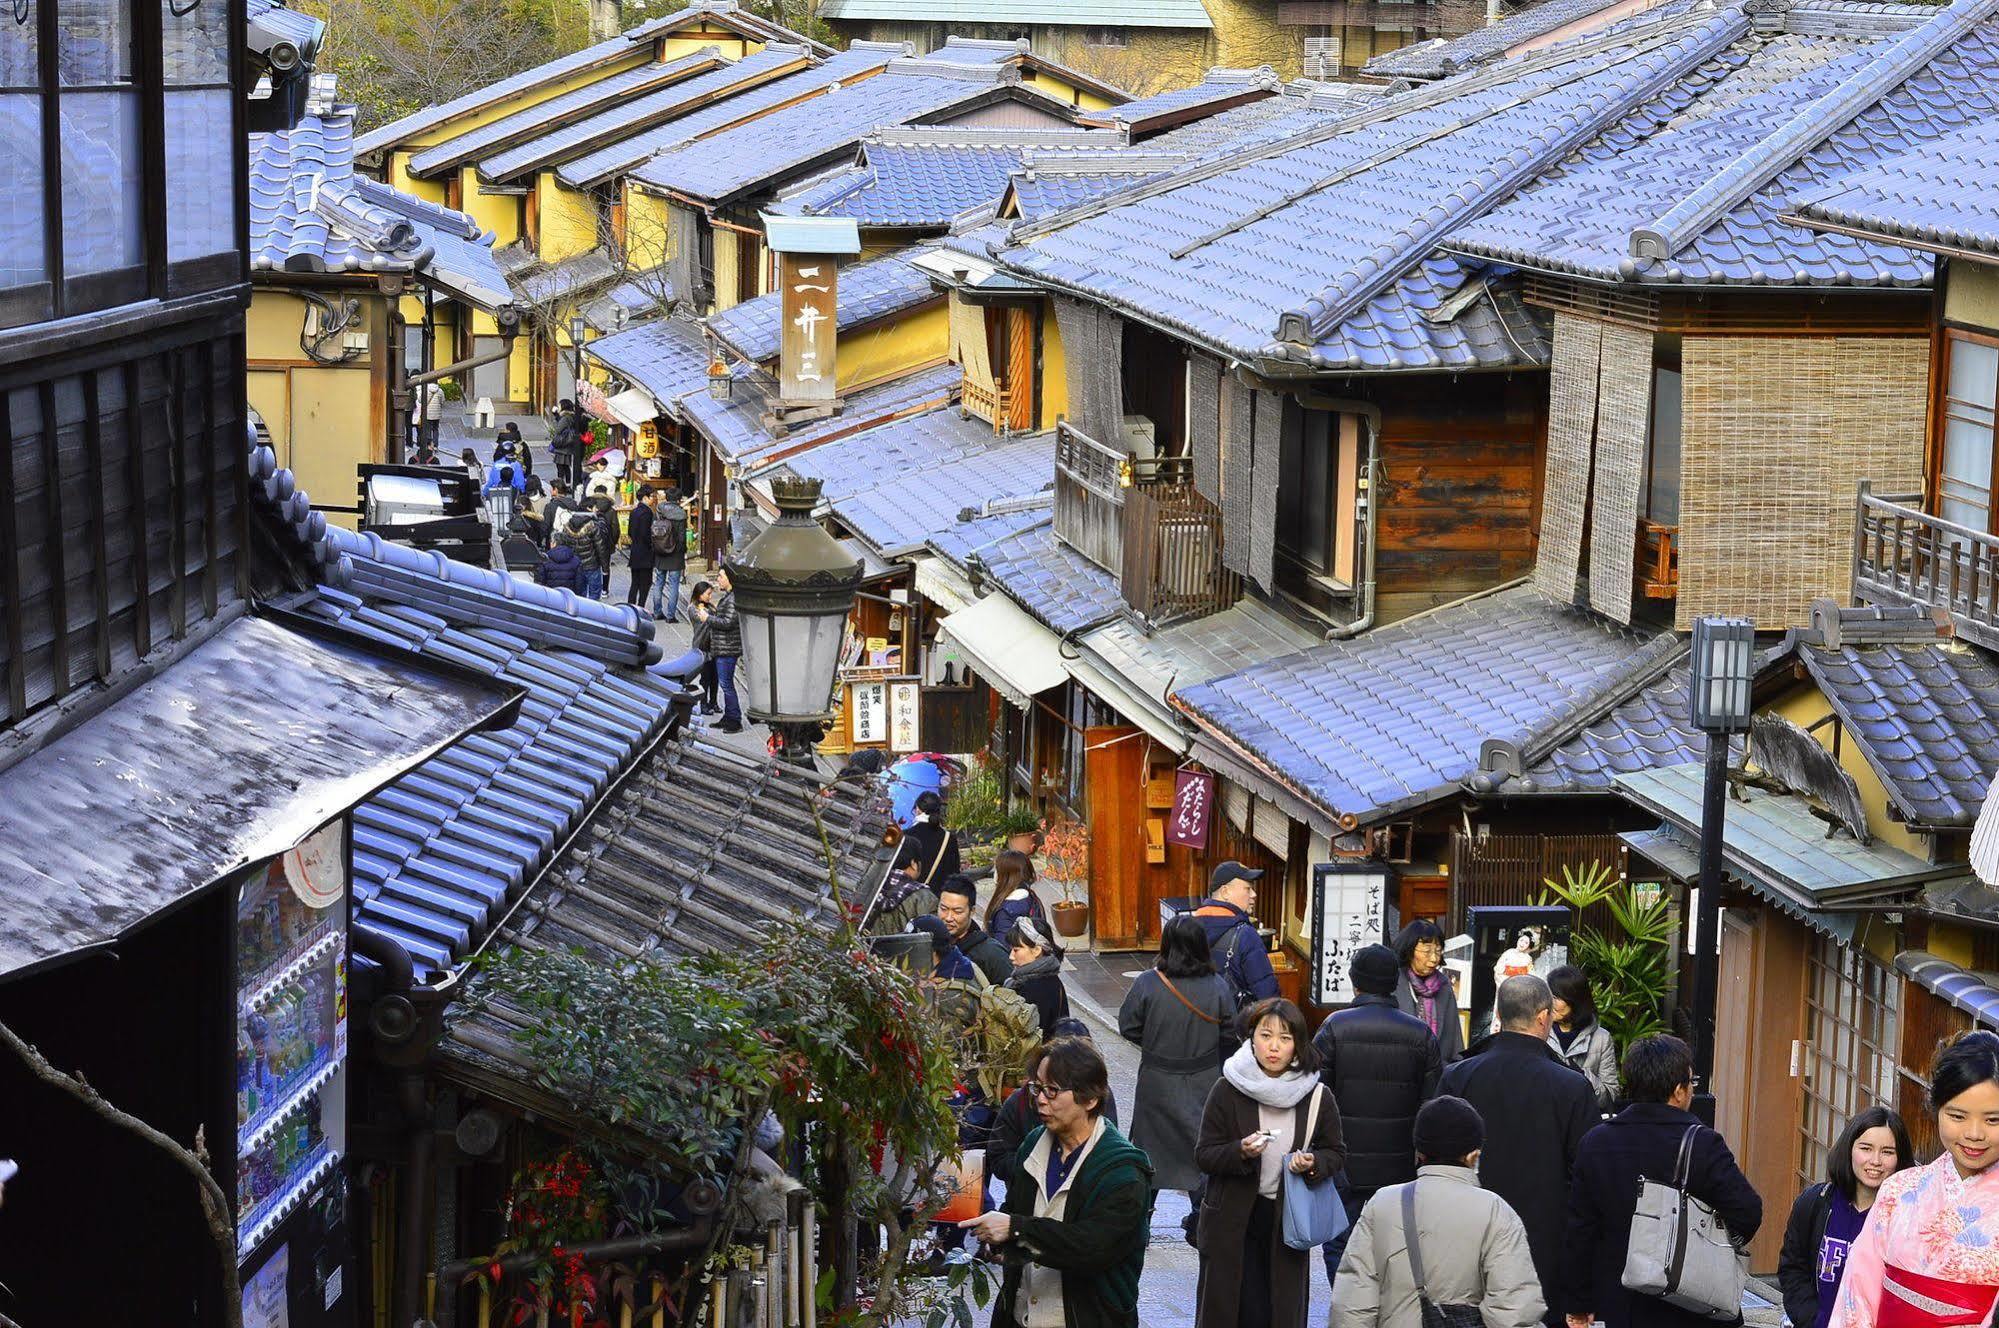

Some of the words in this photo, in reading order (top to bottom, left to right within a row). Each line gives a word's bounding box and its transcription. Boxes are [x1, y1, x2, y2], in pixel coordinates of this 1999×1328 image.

[793, 265, 830, 382] 二井三
[641, 425, 656, 454] 甘酒
[1177, 790, 1195, 839] だんご
[1191, 778, 1206, 836] みたらし
[1366, 885, 1381, 933] そば処
[1325, 939, 1345, 993] ふたば
